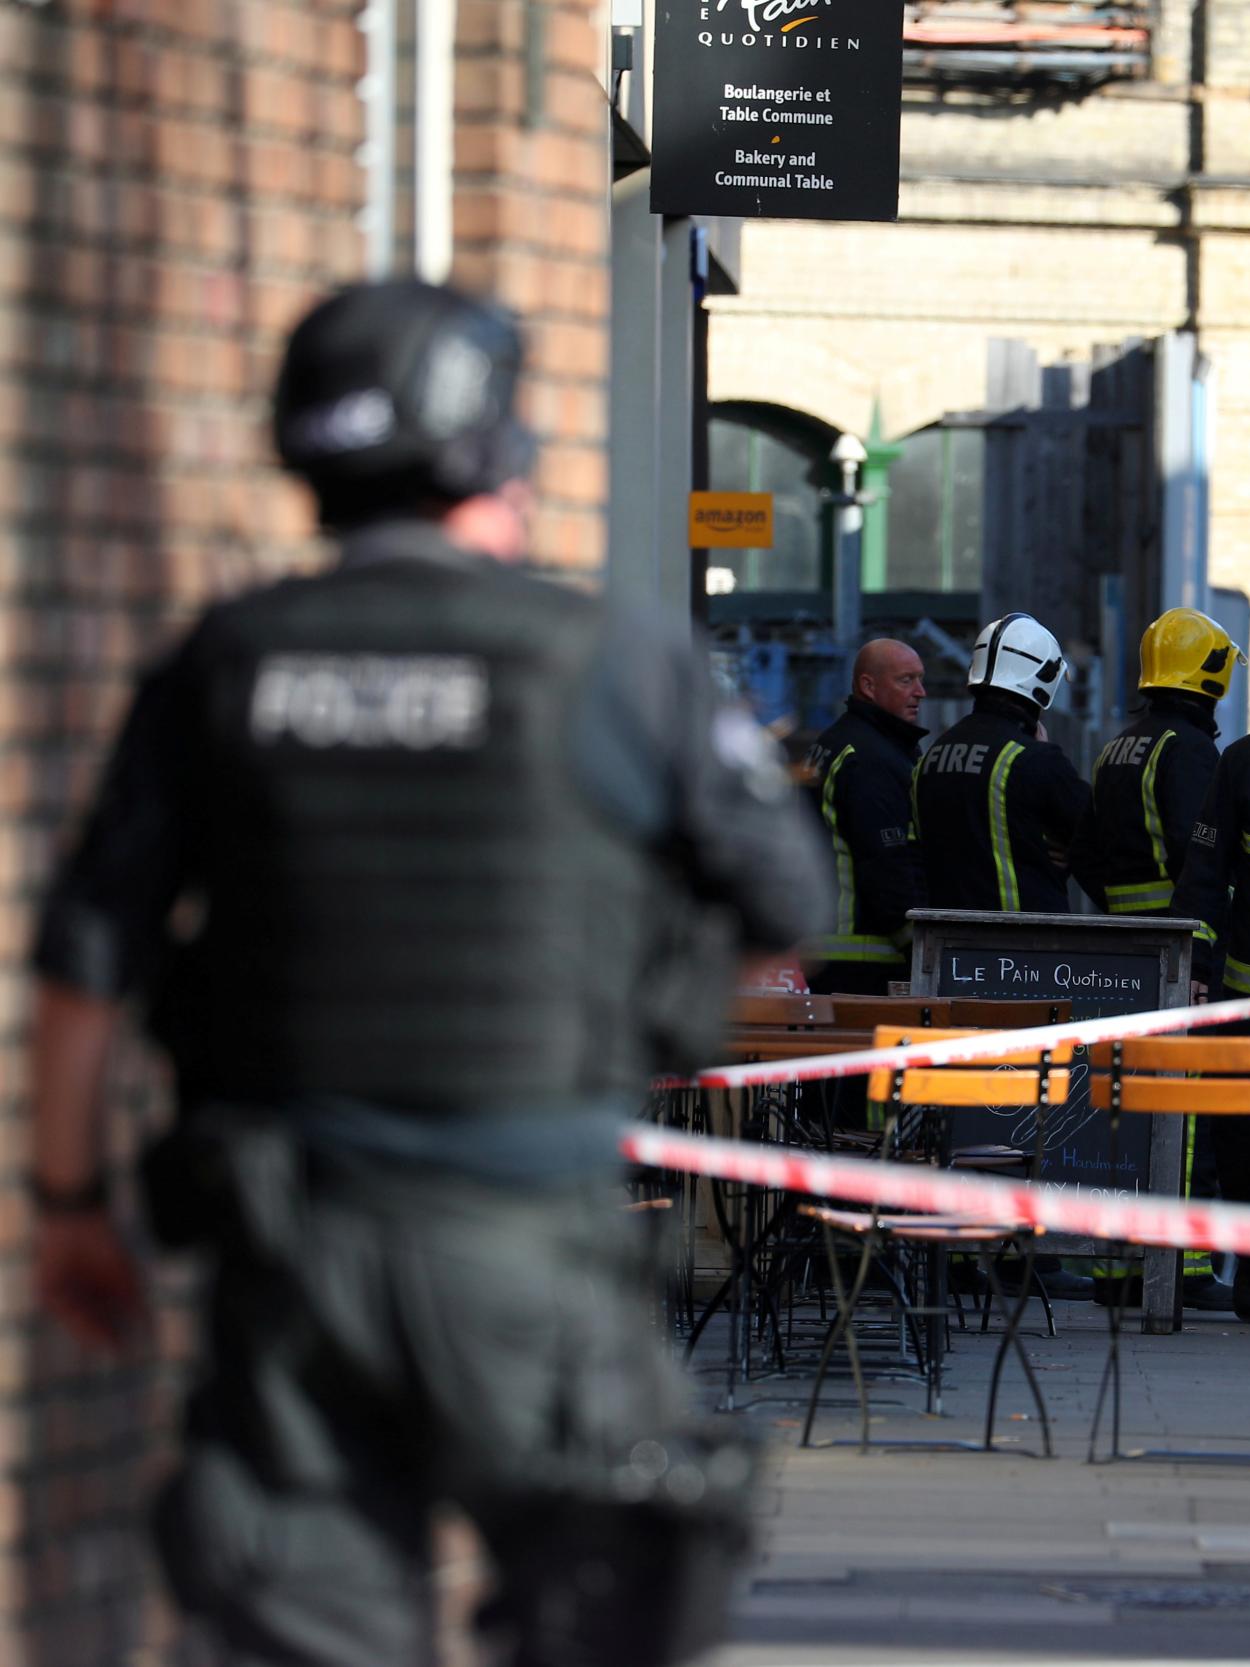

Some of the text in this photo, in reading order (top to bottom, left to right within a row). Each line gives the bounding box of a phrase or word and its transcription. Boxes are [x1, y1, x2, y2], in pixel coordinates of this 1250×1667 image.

[698, 31, 860, 50] QUOTIDIEN
[724, 84, 831, 104] Boulangerie et
[720, 106, 833, 125] Table Commune
[735, 149, 816, 169] Bakery and
[715, 171, 834, 190] Communal Table
[695, 509, 768, 529] amazon
[249, 653, 490, 750] POLICE
[923, 744, 989, 775] FIRE
